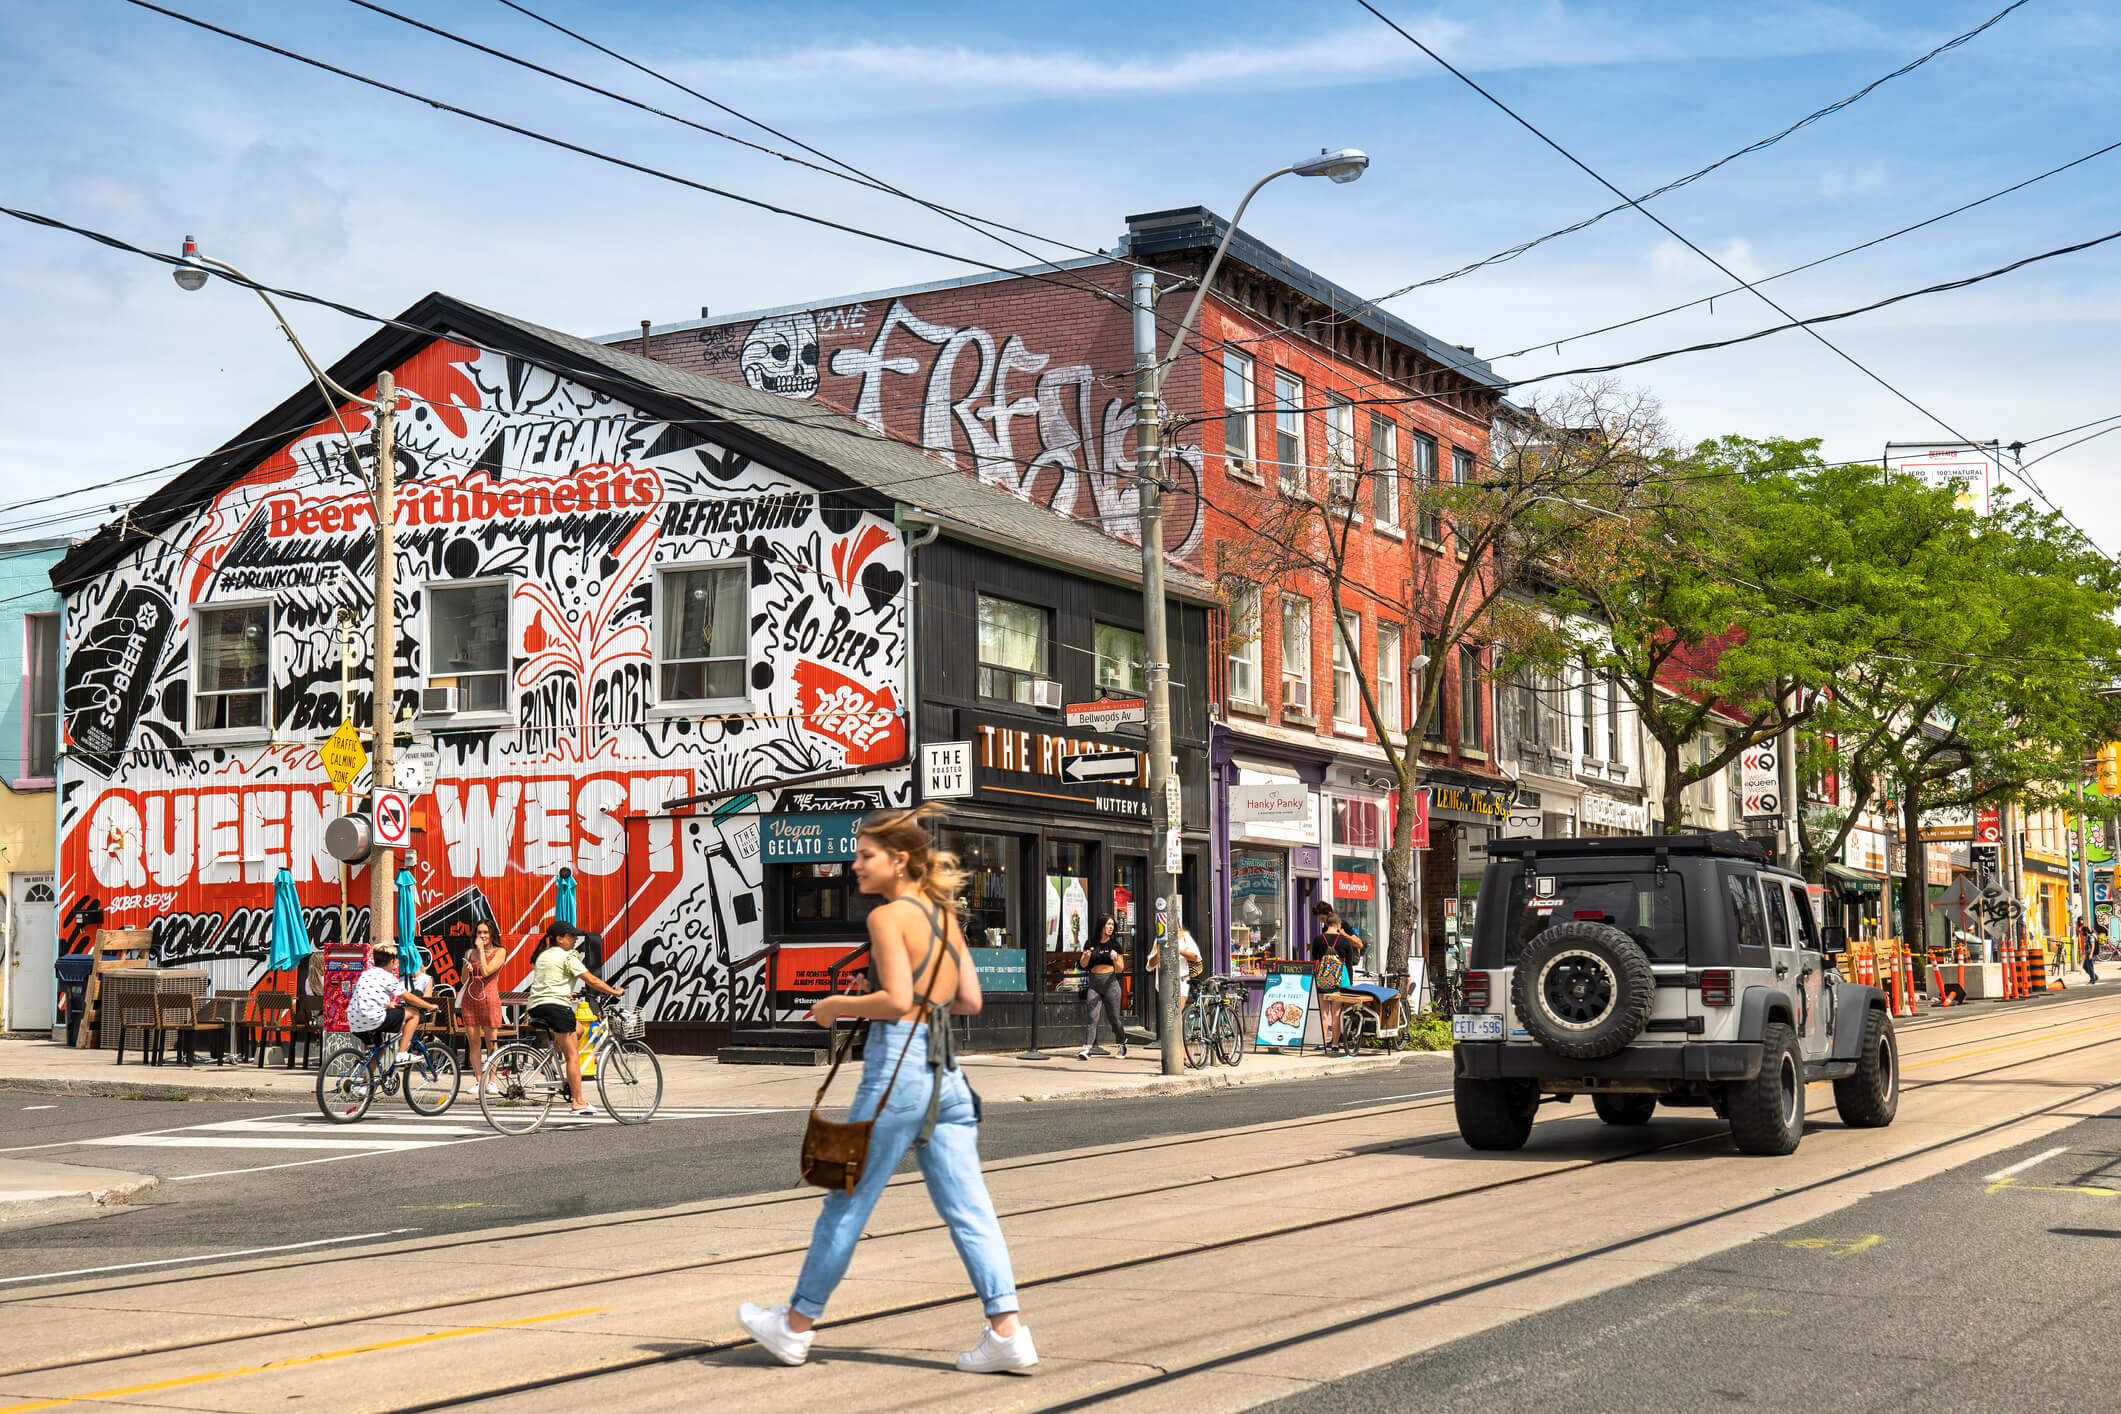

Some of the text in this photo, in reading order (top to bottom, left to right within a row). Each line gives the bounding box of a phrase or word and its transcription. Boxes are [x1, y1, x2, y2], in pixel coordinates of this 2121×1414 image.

[501, 414, 627, 478] VEGAN
[659, 492, 813, 538] REFRESHING
[220, 565, 341, 592] #DRUNKONLIFE
[816, 686, 893, 727] SOLD
[810, 702, 890, 751] HERE!
[1079, 711, 1131, 724] Bellwoods Av
[333, 736, 358, 752] TRAFFIC
[978, 725, 1031, 773] THE
[331, 753, 356, 768] CALMING
[932, 750, 961, 765] THE
[1758, 753, 1775, 771] Q
[334, 770, 349, 785] ZONE
[933, 775, 962, 790] NUT
[1748, 779, 1776, 787] queen
[1096, 797, 1148, 816] NUTTERY &
[1247, 798, 1304, 811] Hanky Panky
[1760, 794, 1778, 812] Q
[438, 774, 690, 878] WEST
[738, 827, 756, 841] THE
[769, 819, 823, 842] Vegan
[743, 841, 760, 856] NUT
[769, 838, 821, 856] GELATO
[840, 837, 858, 853] CO
[144, 892, 178, 912] SEXY
[1455, 1021, 1501, 1034] CETL 596
